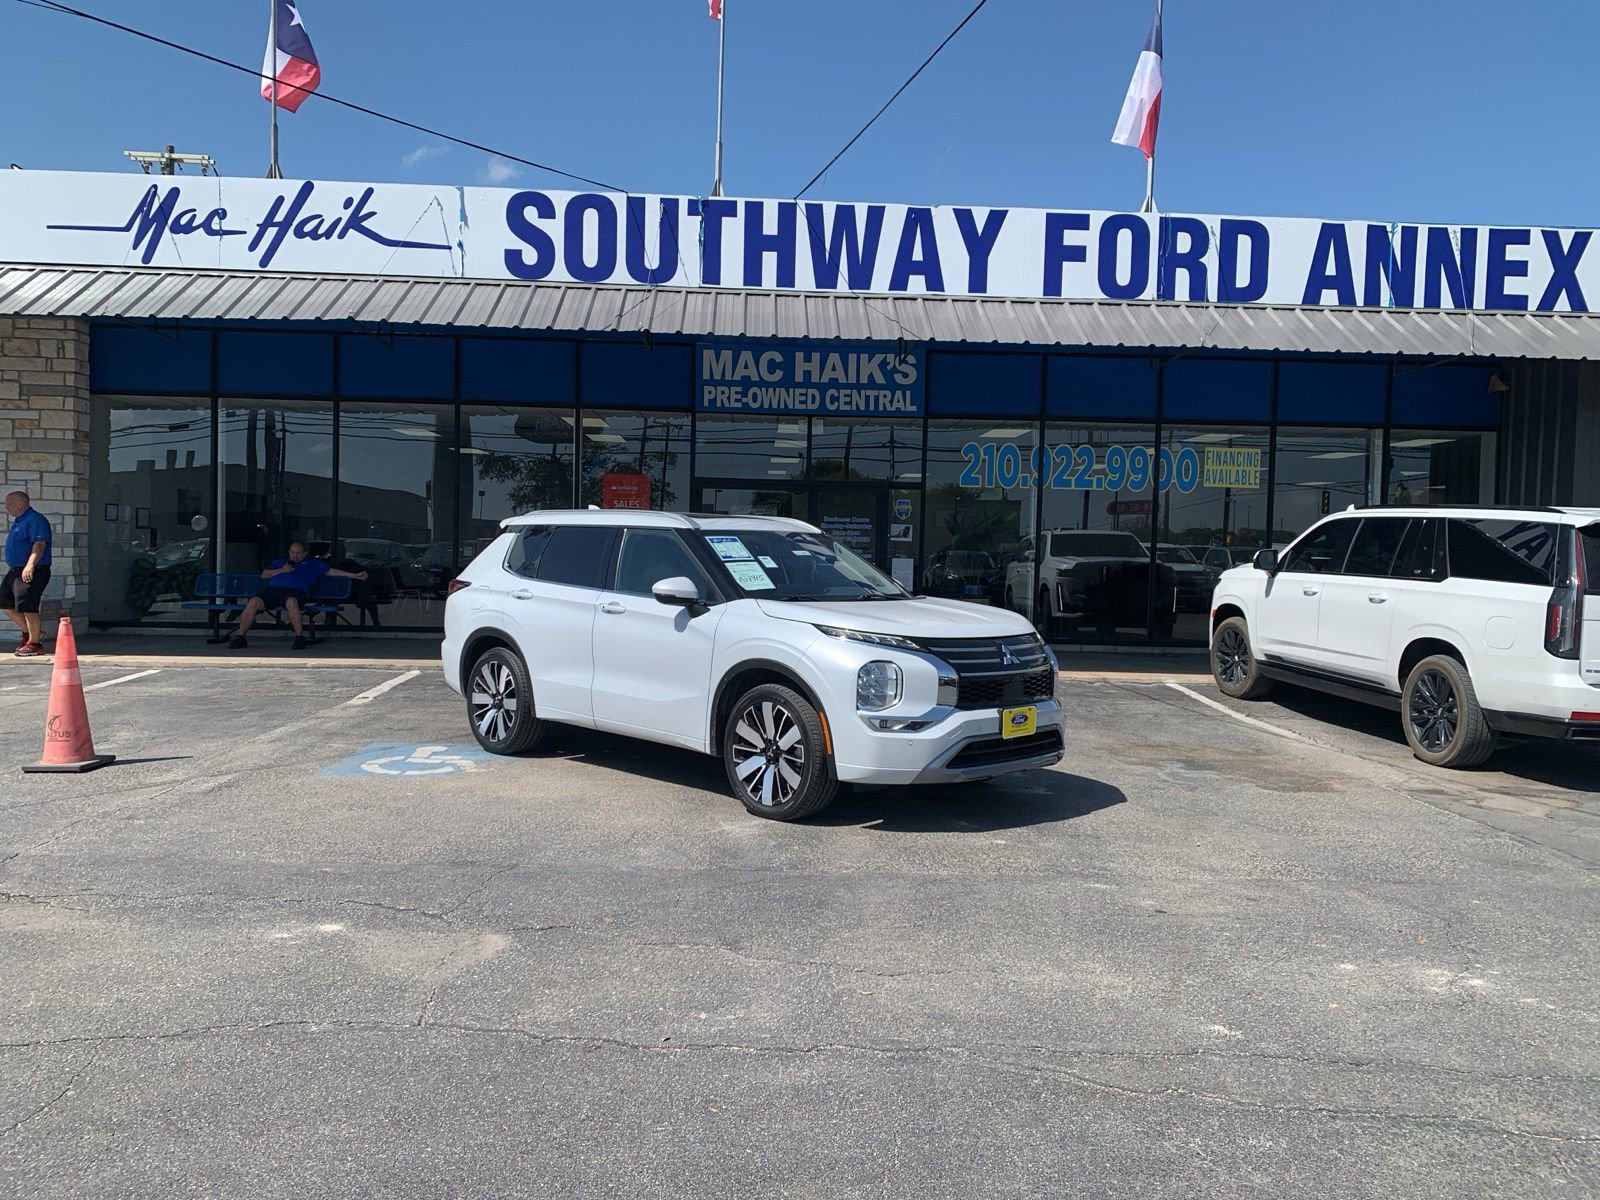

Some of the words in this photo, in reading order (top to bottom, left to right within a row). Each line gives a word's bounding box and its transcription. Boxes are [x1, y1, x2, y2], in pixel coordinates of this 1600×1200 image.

[47, 183, 247, 265] Mac
[248, 180, 453, 268] Haik
[504, 190, 1009, 293] SOUTHWAY
[1043, 212, 1270, 304] FORD
[1302, 221, 1591, 312] ANNEX
[702, 349, 784, 382] MAC
[795, 352, 918, 385] HAIK'S
[703, 386, 820, 410] PRE-OWNED
[825, 390, 917, 411] CENTRAL
[960, 442, 1199, 493] 210.922.9900
[1205, 450, 1260, 467] FINANCING
[1205, 469, 1260, 486] AVAILABLE
[613, 500, 640, 509] SALES
